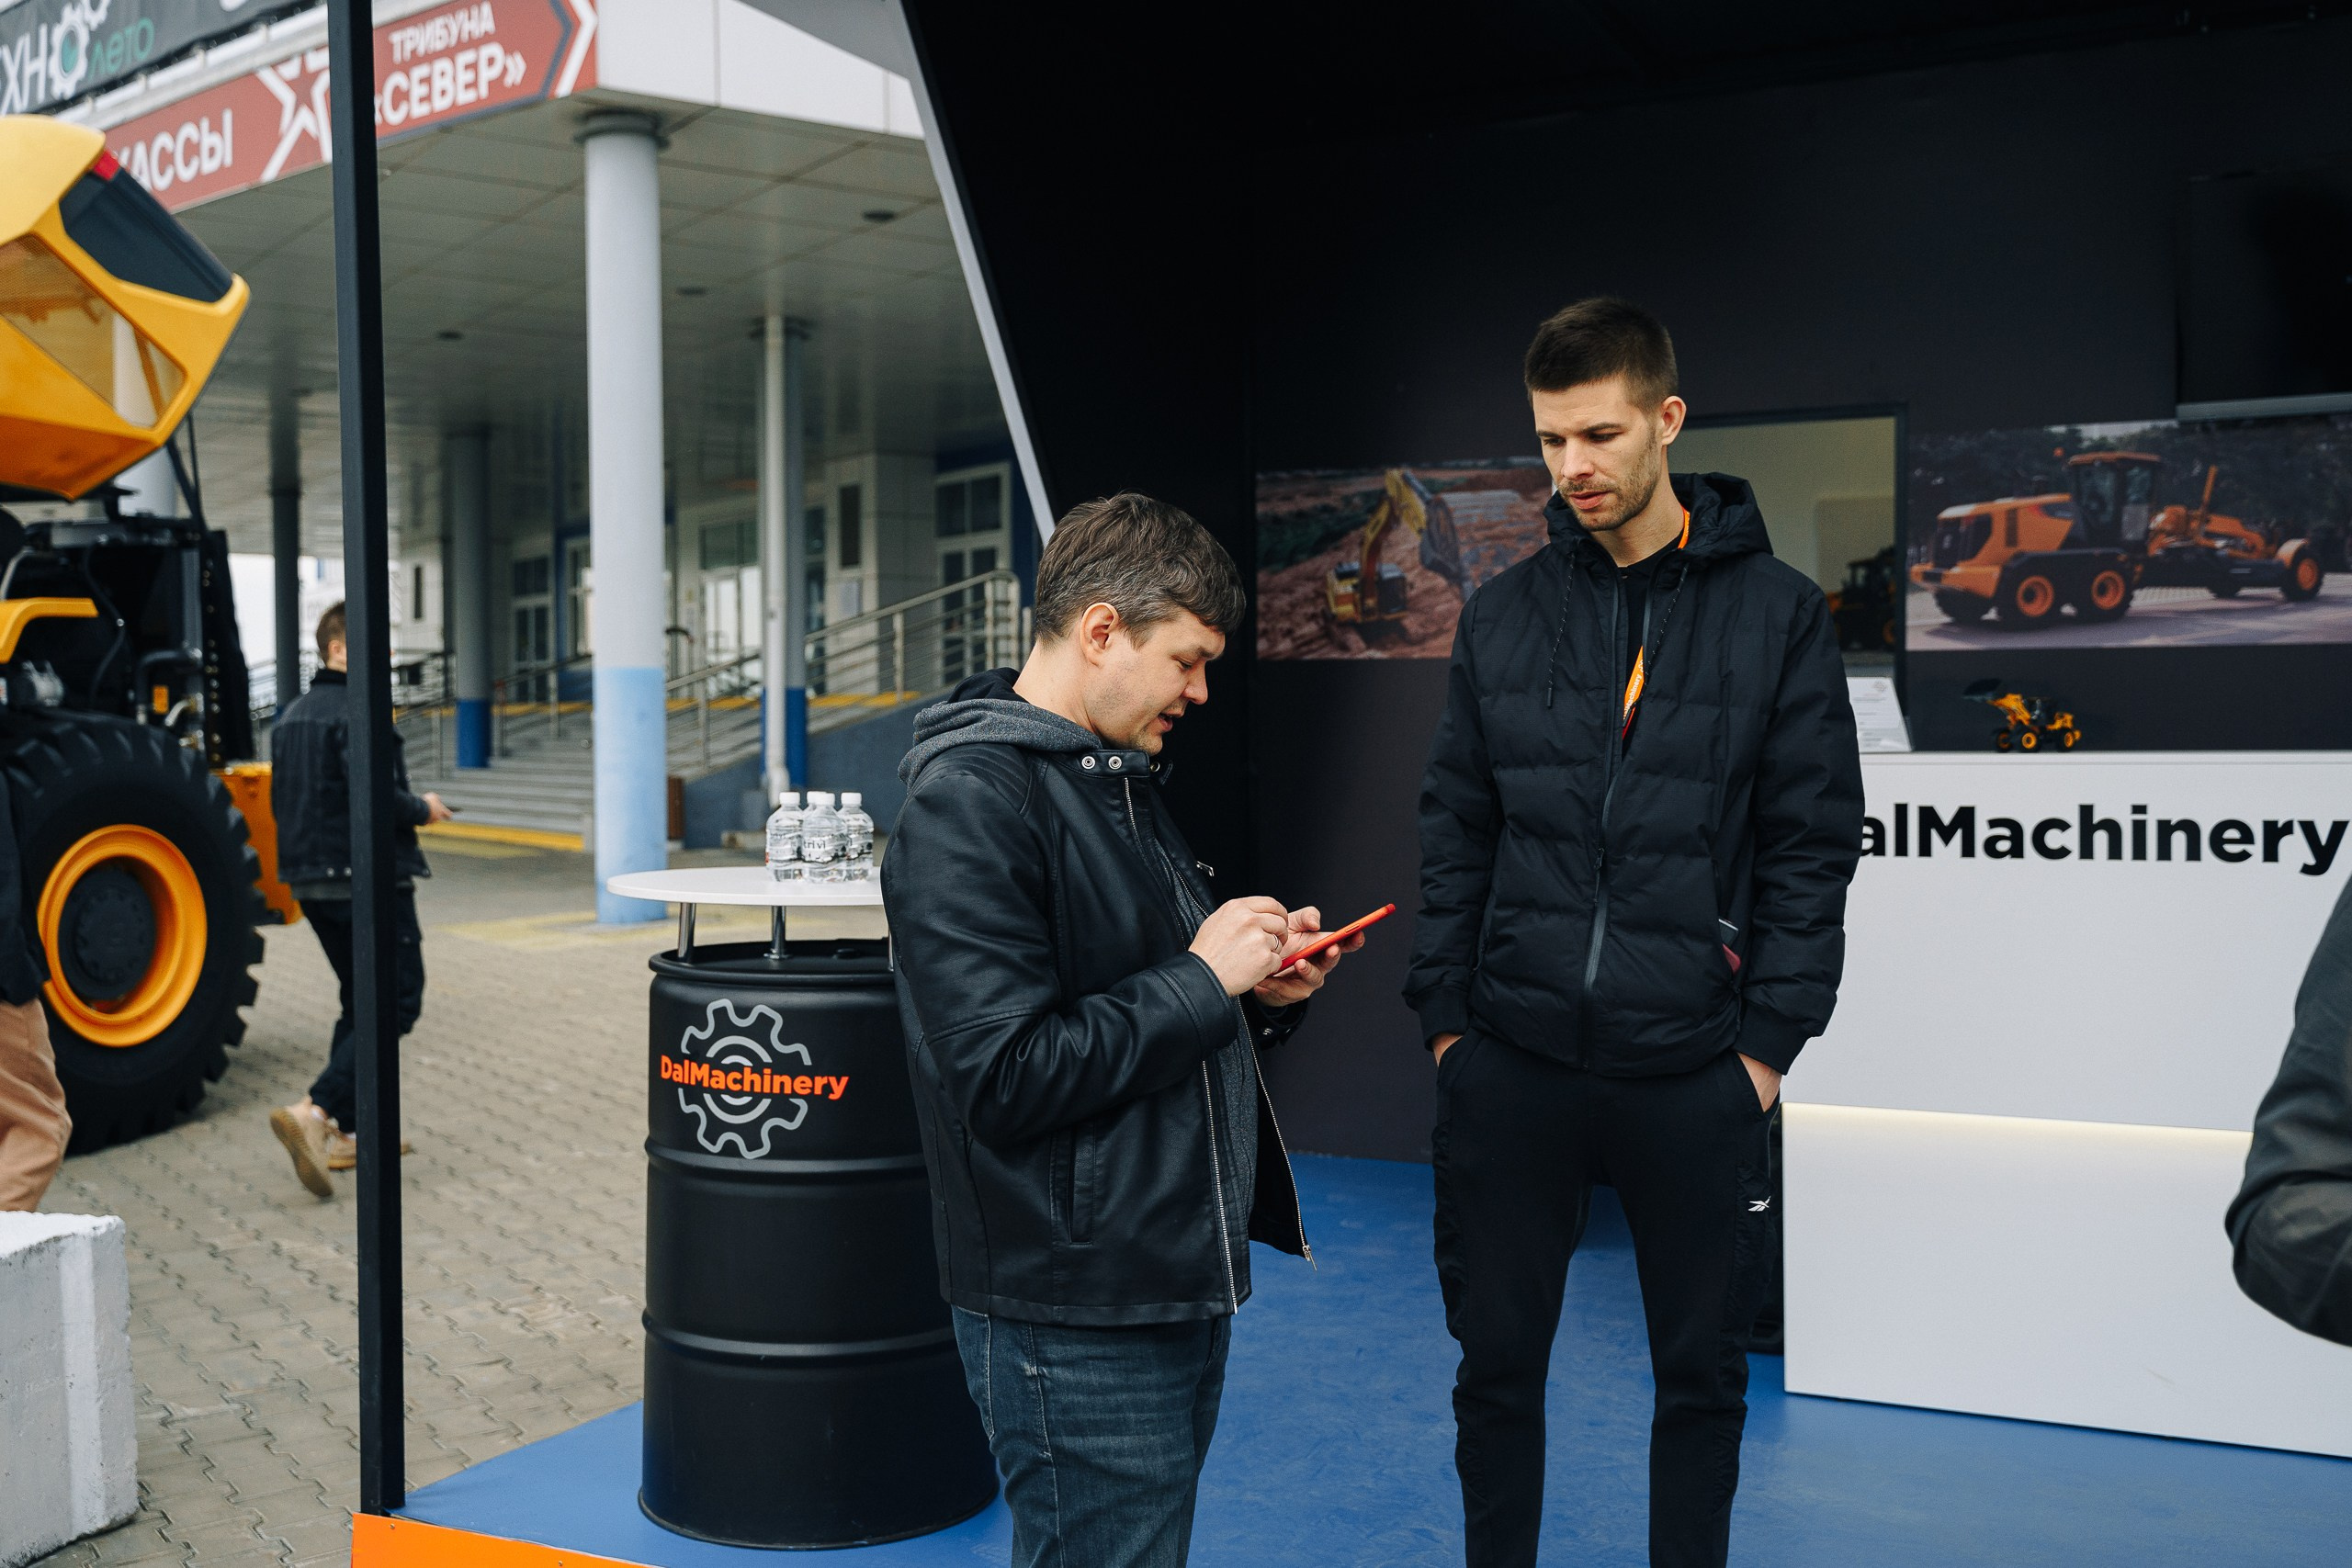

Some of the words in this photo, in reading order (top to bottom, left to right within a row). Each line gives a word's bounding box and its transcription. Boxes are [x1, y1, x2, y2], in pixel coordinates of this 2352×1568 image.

[389, 1, 496, 64] ТРИБУНА
[1861, 803, 2351, 876] alMachinery
[661, 1055, 849, 1100] DalMachinery
